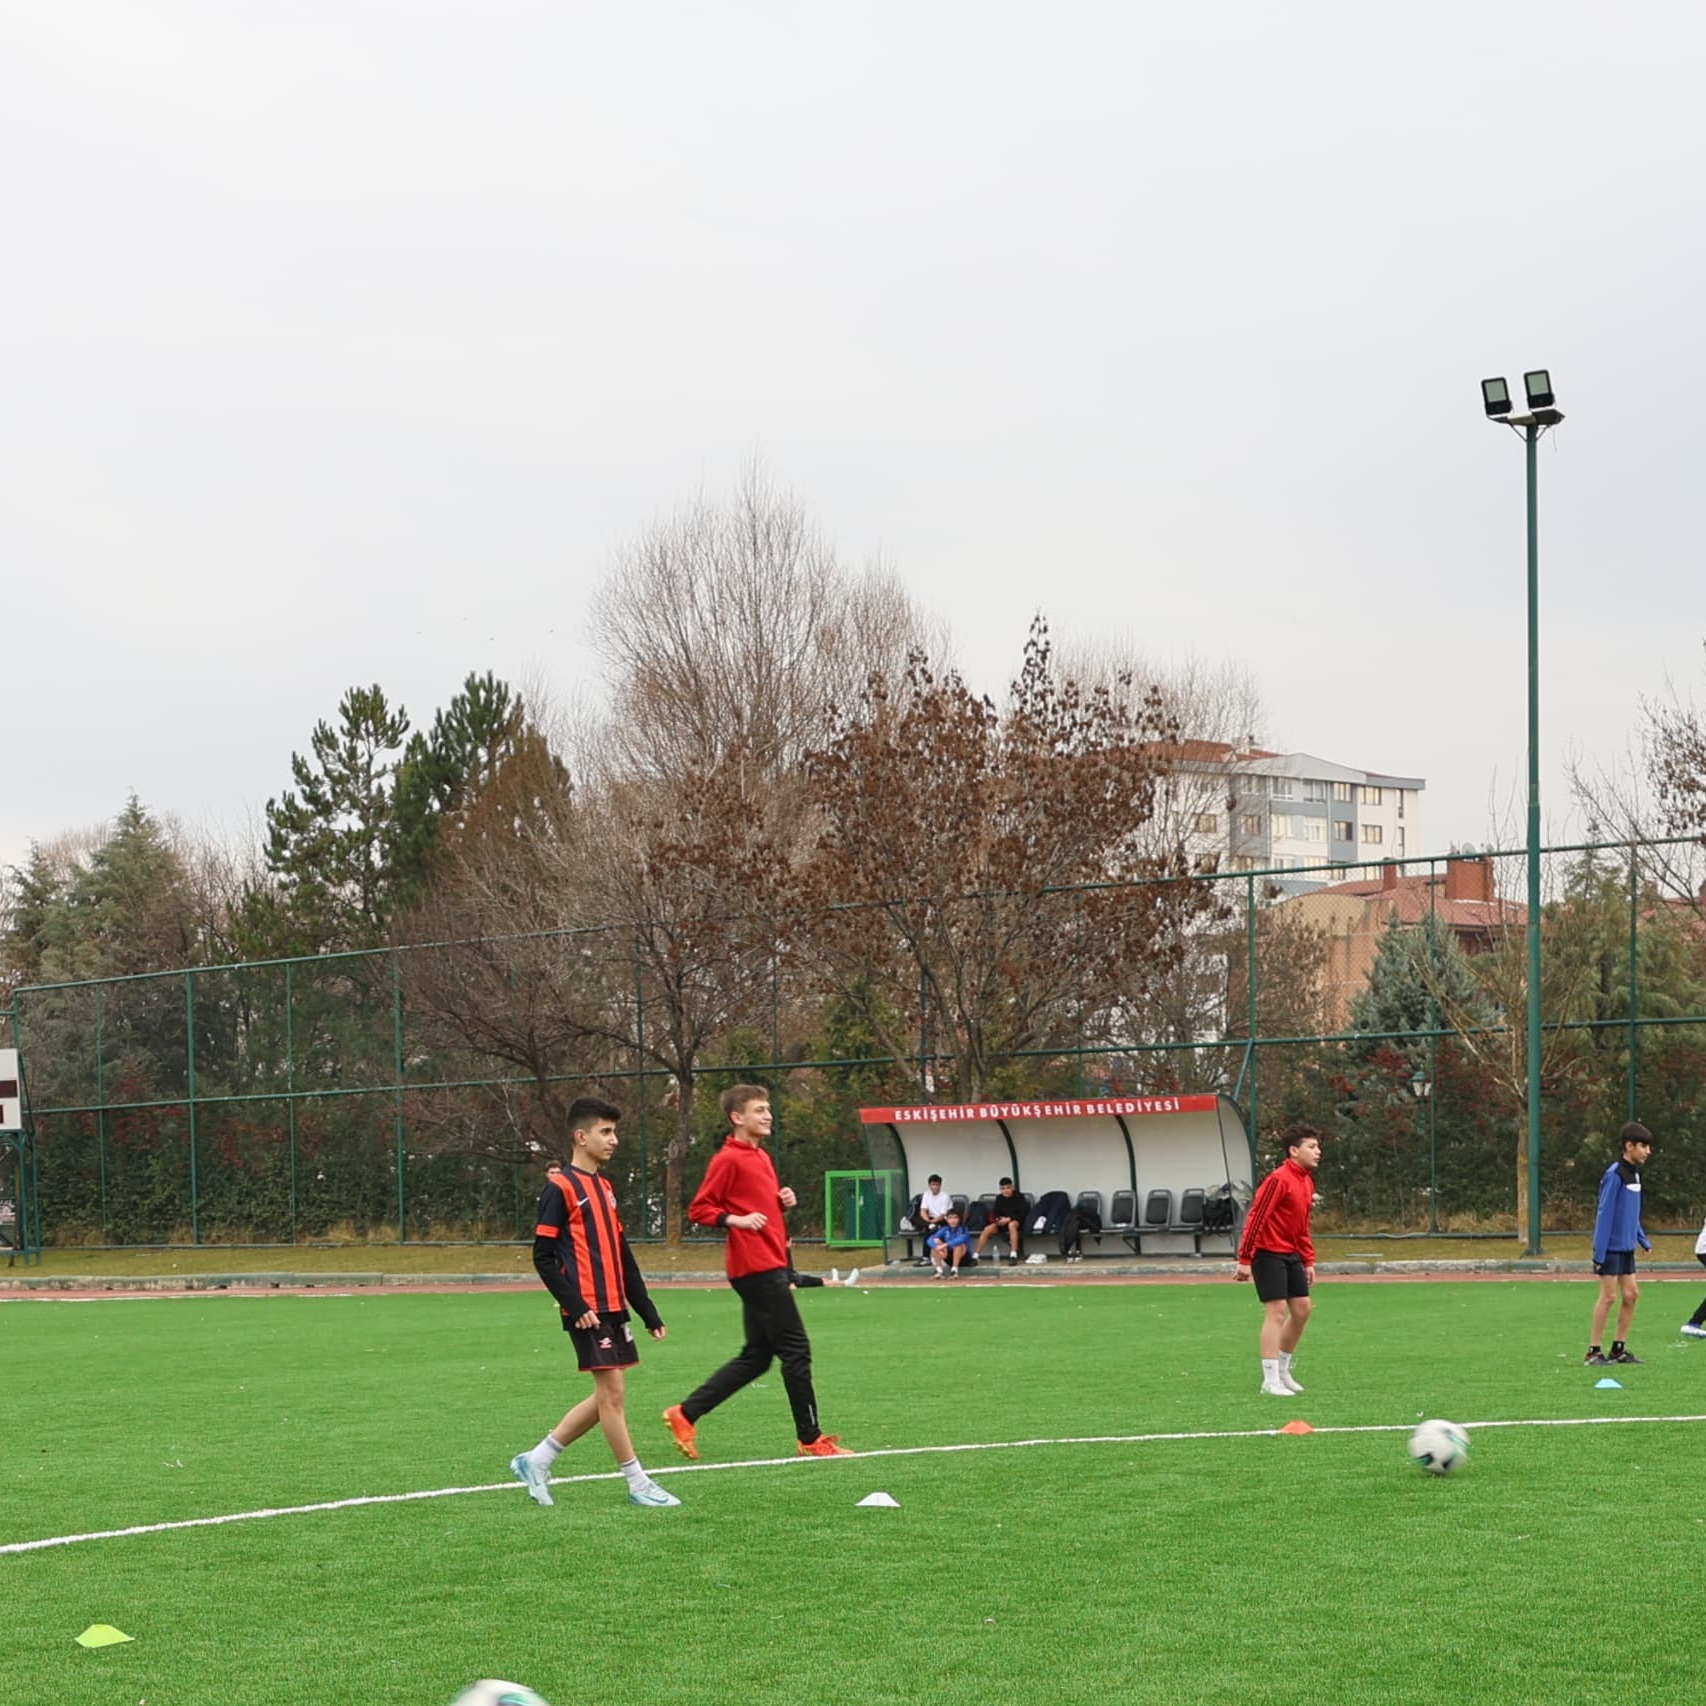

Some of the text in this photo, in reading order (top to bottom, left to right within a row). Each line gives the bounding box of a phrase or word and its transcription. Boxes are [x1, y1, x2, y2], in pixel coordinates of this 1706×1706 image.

[894, 1096, 1181, 1122] ESKİŞEHİR BÜYÜKŞEHİR BELEDİYESİ
